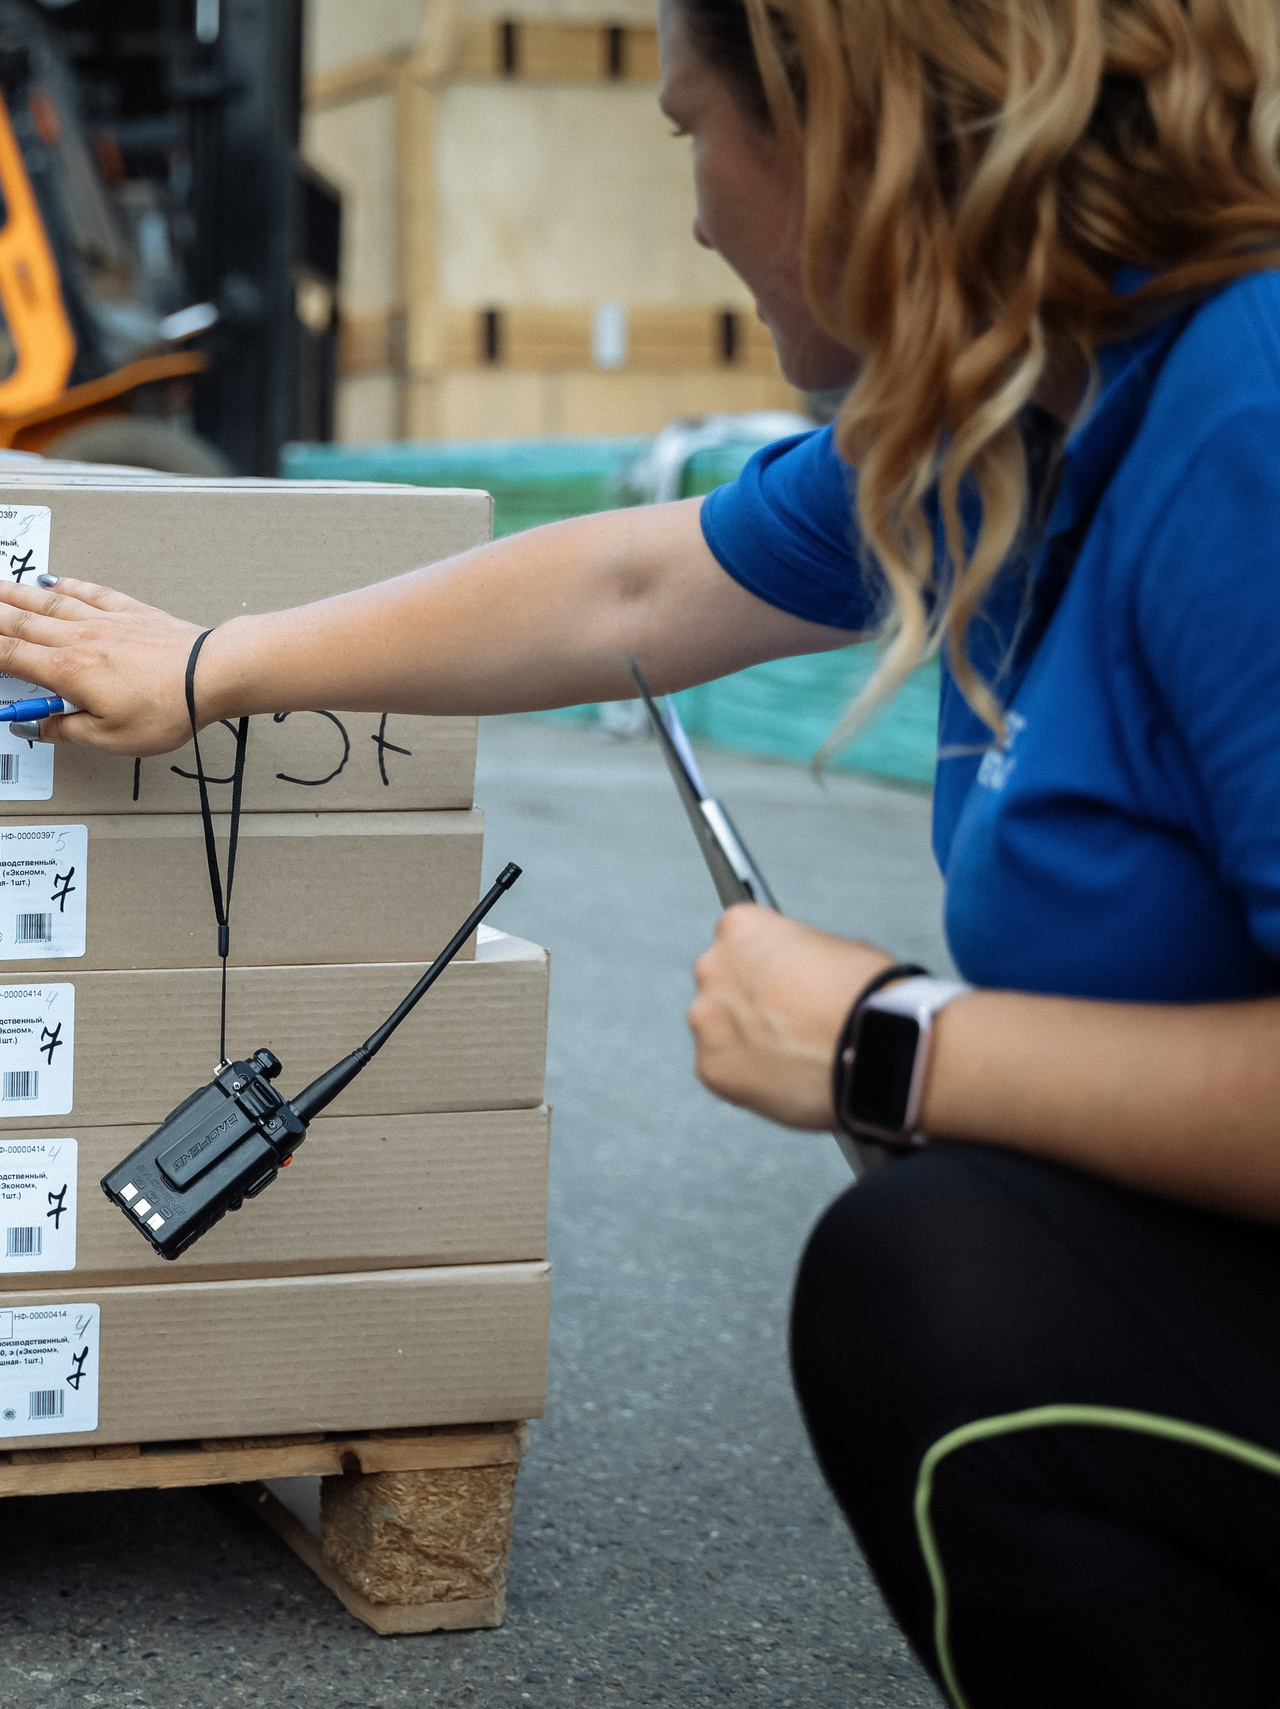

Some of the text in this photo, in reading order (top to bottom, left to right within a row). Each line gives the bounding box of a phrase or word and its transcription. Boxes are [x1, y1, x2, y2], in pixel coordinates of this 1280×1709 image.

[1, 831, 55, 840] НФ-00000397
[11, 879, 31, 887] 1шт.)
[51, 867, 76, 913] 7
[40, 1022, 63, 1065] 7
[172, 1112, 239, 1173] BAOFENG
[2, 1192, 21, 1201] 1шт.)
[47, 1184, 67, 1230] 7
[14, 1310, 67, 1321] НФ-00000414
[24, 1357, 43, 1366] 1шт.)
